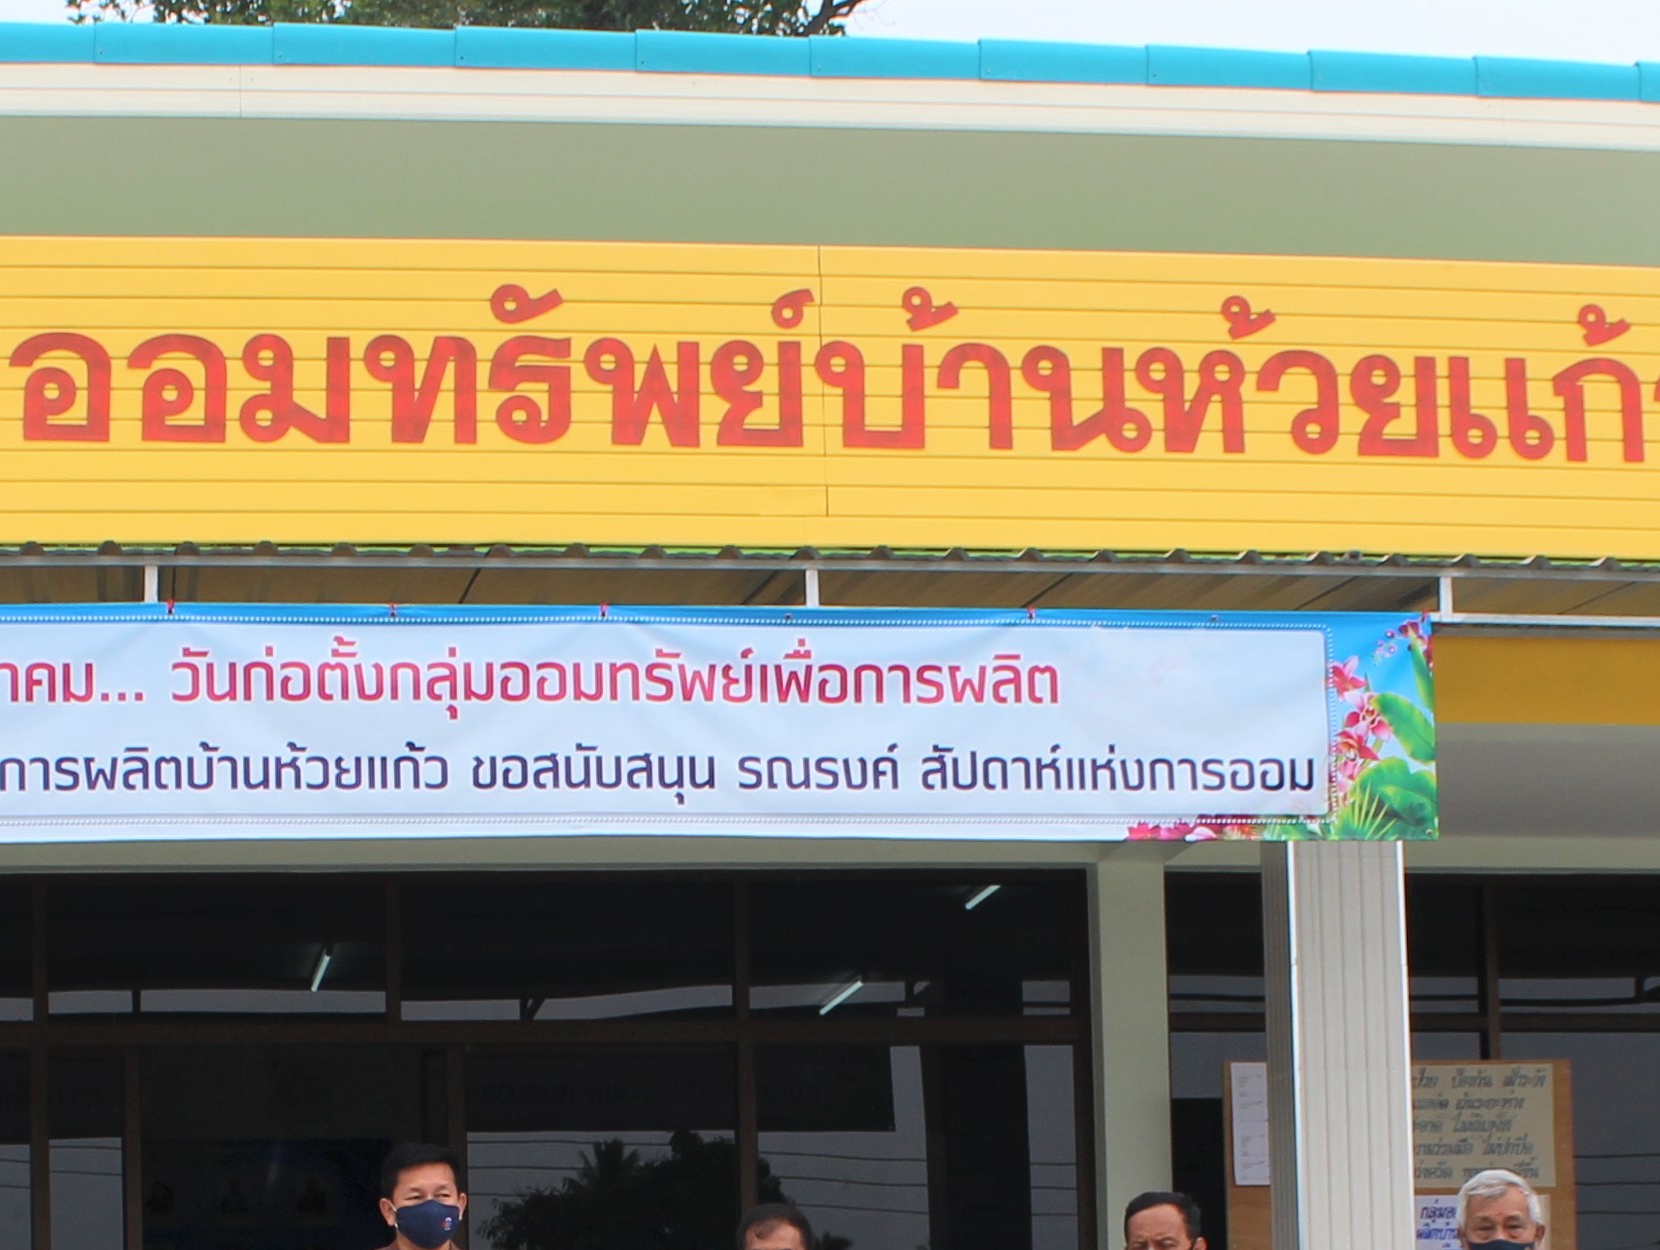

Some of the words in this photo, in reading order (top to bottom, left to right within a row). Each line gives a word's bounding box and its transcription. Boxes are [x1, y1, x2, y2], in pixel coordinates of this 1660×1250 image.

[170, 635, 1060, 720] วันก่อตั้งกลุ่มออมทรัพย์เพื่อการผลิต
[471, 741, 716, 806] ขอสนับสนุน
[737, 742, 899, 791] รณรงค์
[921, 742, 1315, 792] สัปดาห์แห่งการออม
